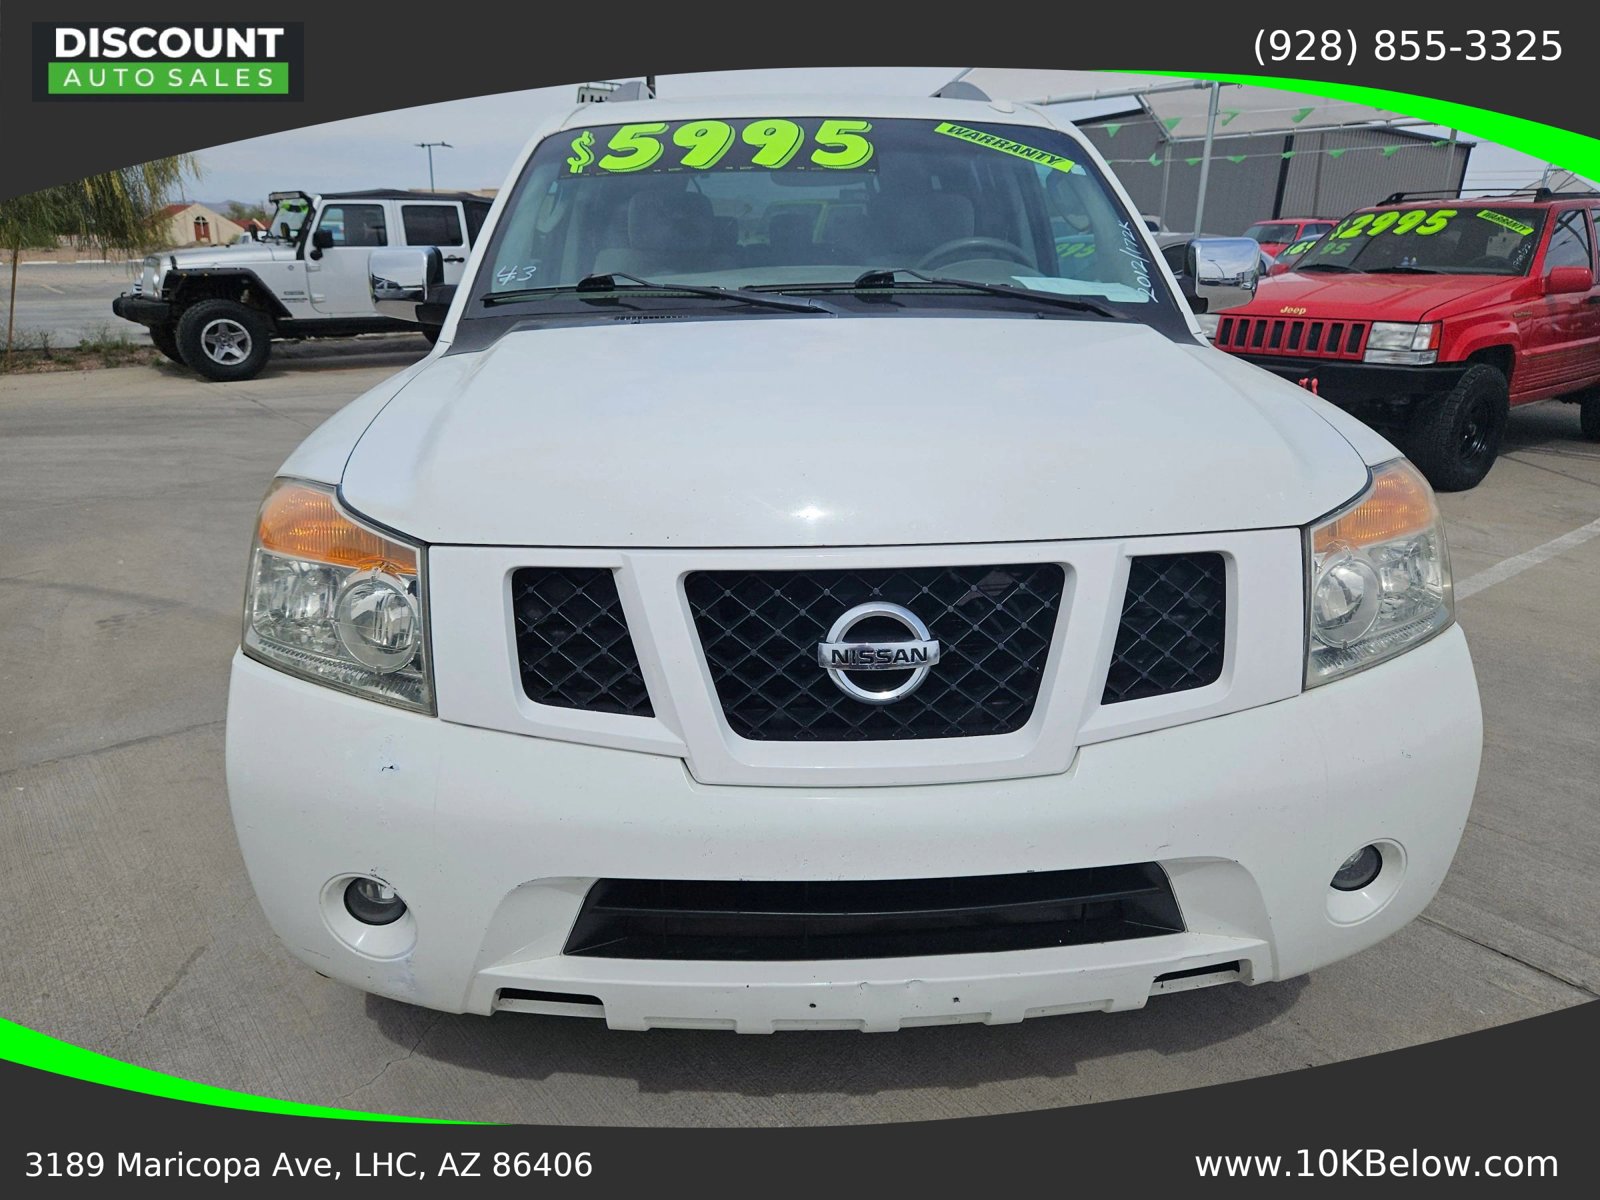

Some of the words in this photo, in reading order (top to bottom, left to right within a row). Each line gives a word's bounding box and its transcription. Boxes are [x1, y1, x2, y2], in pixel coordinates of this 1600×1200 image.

[567, 119, 874, 174] $5995
[947, 125, 1065, 165] WARRANTY
[1329, 209, 1458, 241] $2995
[497, 265, 536, 286] 43
[1280, 306, 1307, 315] Jeep
[831, 647, 928, 666] NISSAN
